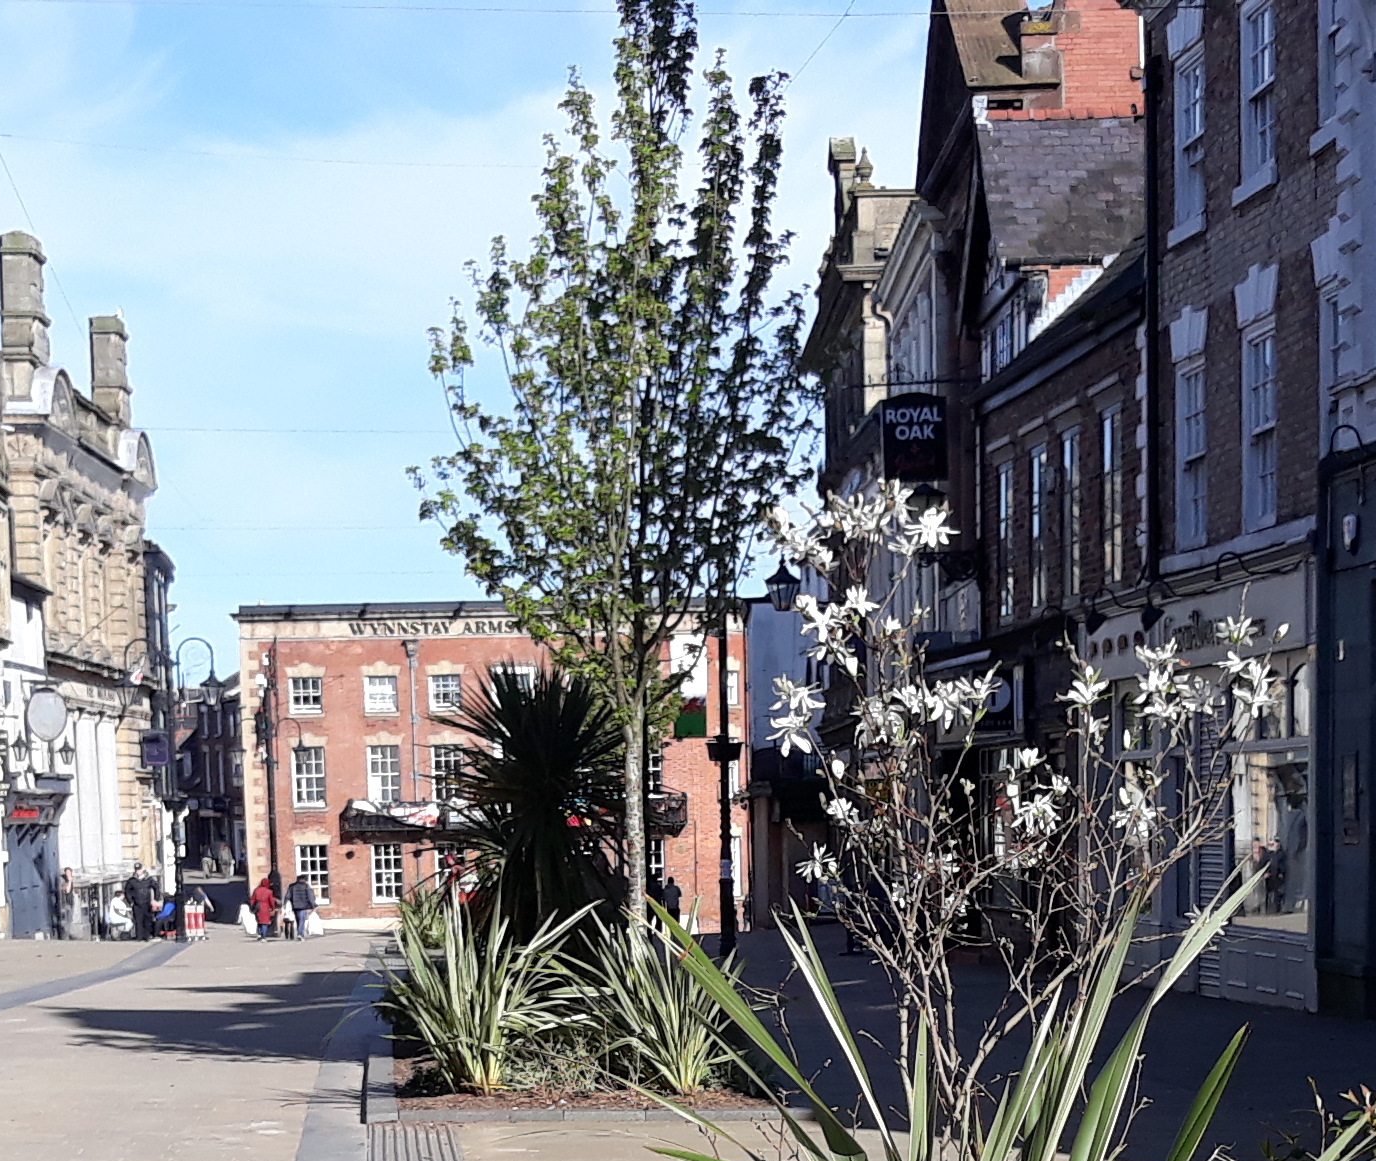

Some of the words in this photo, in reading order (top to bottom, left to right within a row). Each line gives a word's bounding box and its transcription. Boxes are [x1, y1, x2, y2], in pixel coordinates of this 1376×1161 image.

[885, 406, 942, 424] ROYAL
[895, 424, 935, 440] OAK
[348, 621, 452, 636] WYNNSTAY
